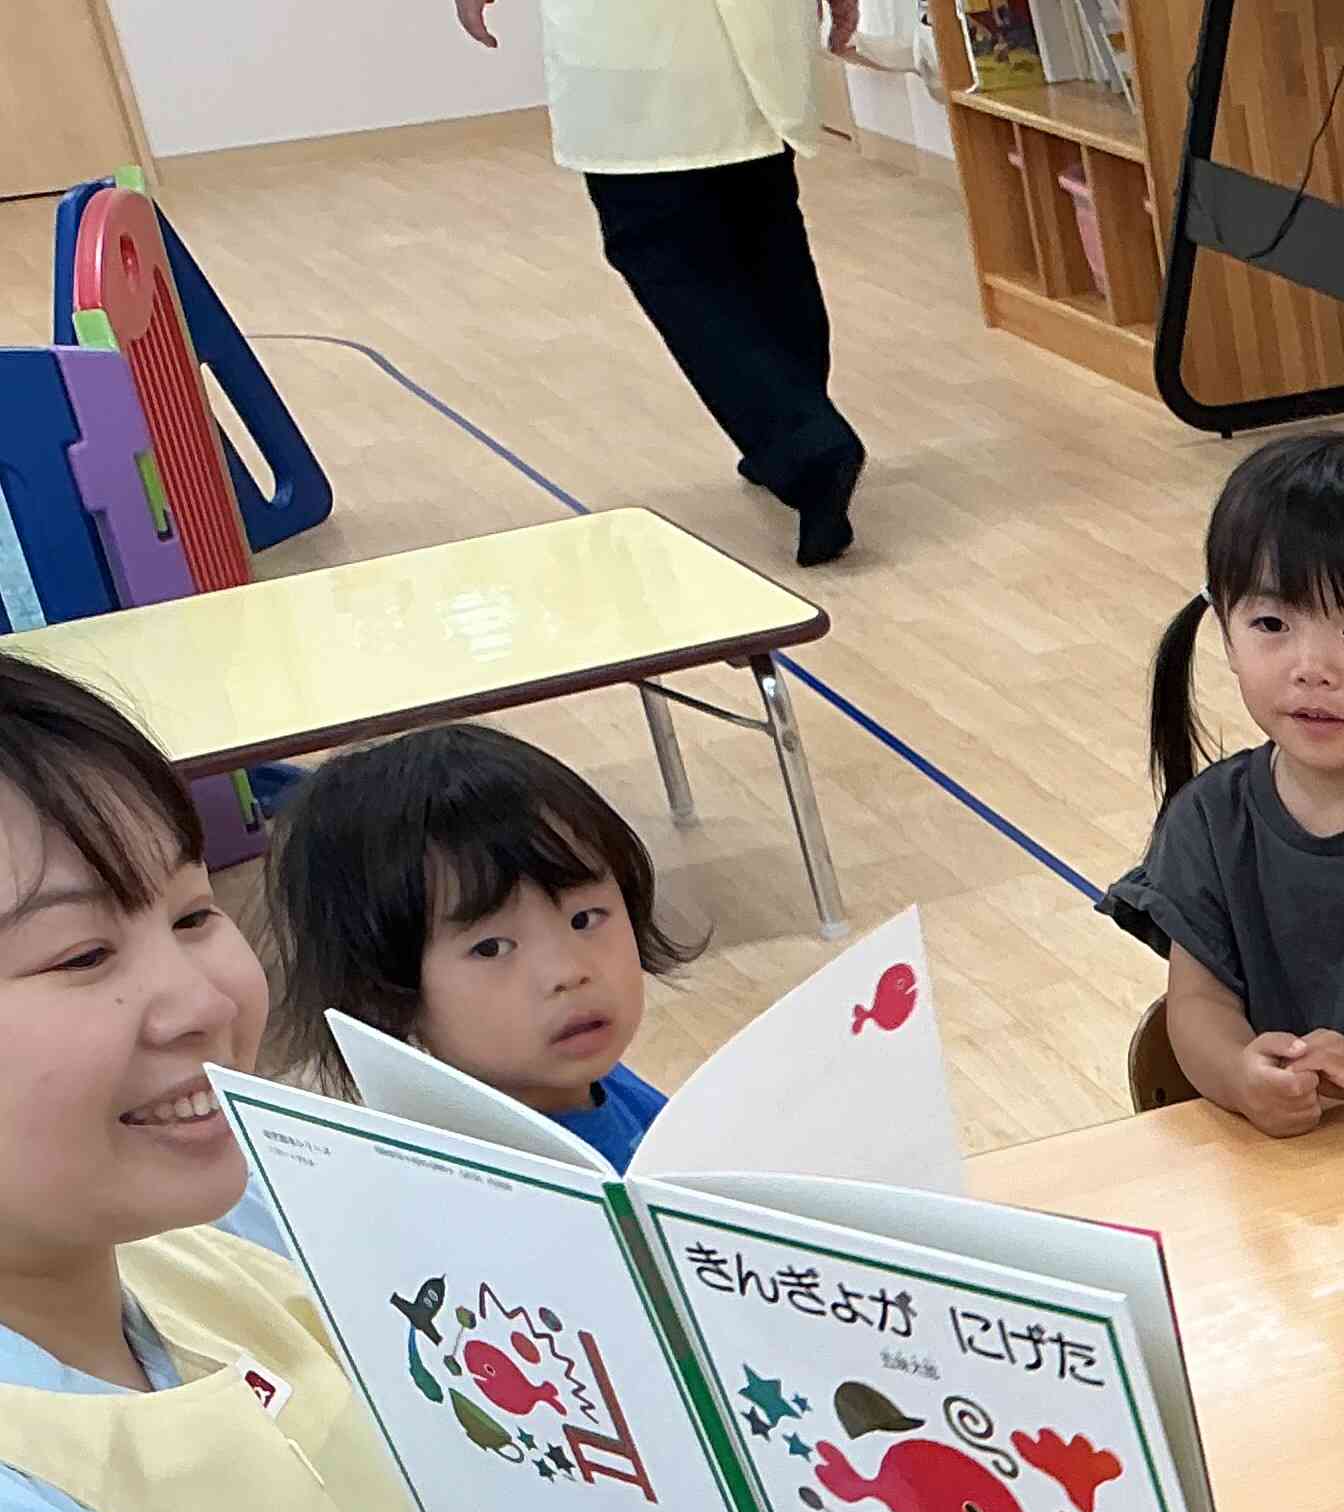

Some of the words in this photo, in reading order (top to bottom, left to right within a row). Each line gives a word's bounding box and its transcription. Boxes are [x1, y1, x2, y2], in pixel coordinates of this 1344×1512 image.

[685, 1241, 918, 1338] きんぎょが
[949, 1306, 1105, 1387] にげた
